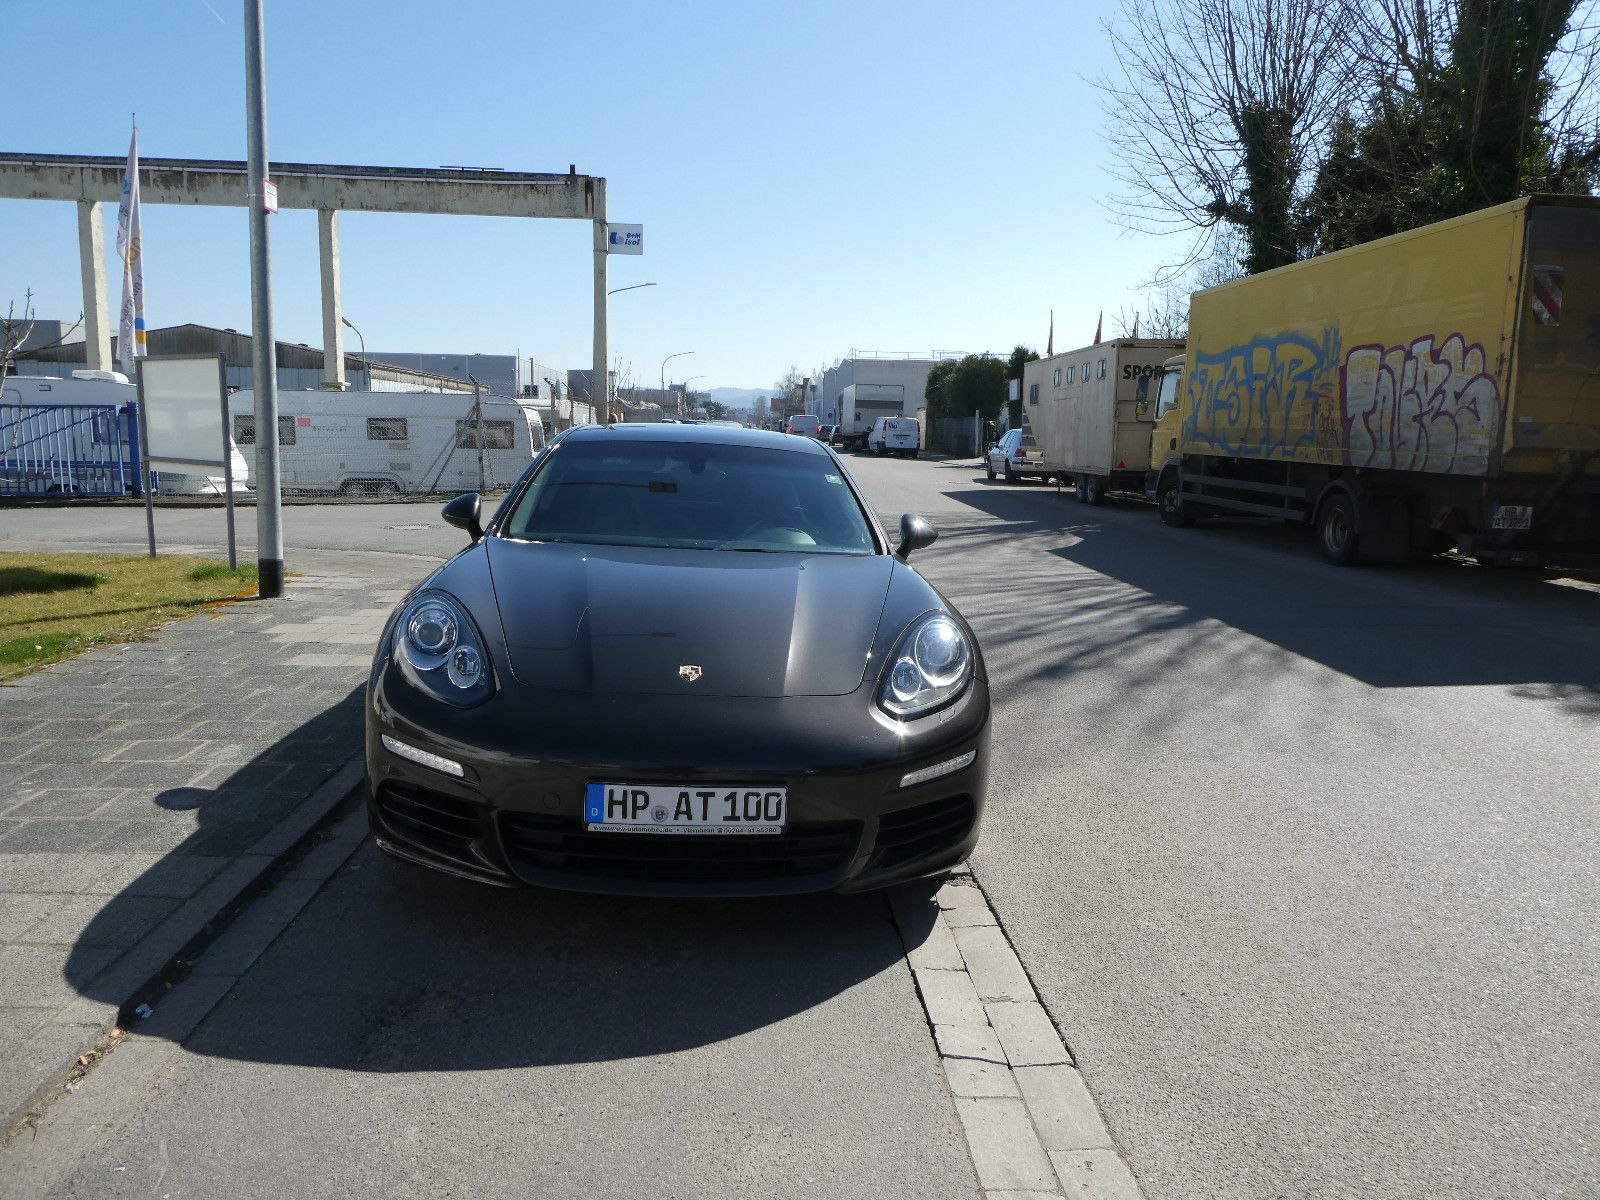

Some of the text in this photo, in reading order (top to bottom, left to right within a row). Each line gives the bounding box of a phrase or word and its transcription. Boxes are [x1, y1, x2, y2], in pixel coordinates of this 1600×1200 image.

[591, 808, 599, 817] D
[608, 789, 782, 821] HP AT 100
